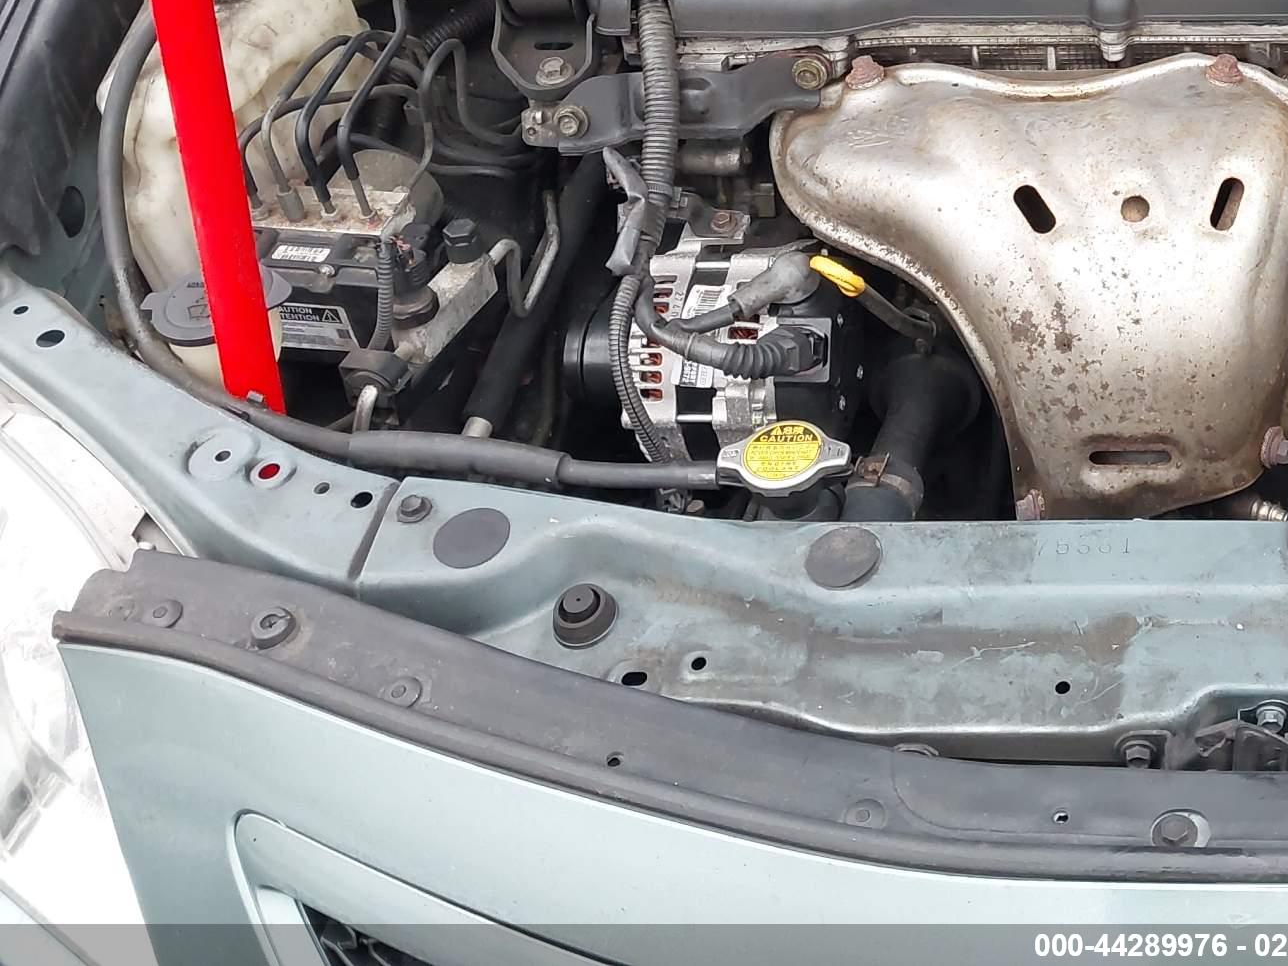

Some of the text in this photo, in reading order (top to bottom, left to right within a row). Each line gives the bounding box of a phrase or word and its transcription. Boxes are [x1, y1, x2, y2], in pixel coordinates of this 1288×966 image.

[278, 306, 313, 314] AUTION
[280, 313, 321, 321] TENTION
[759, 434, 813, 443] CAUTION
